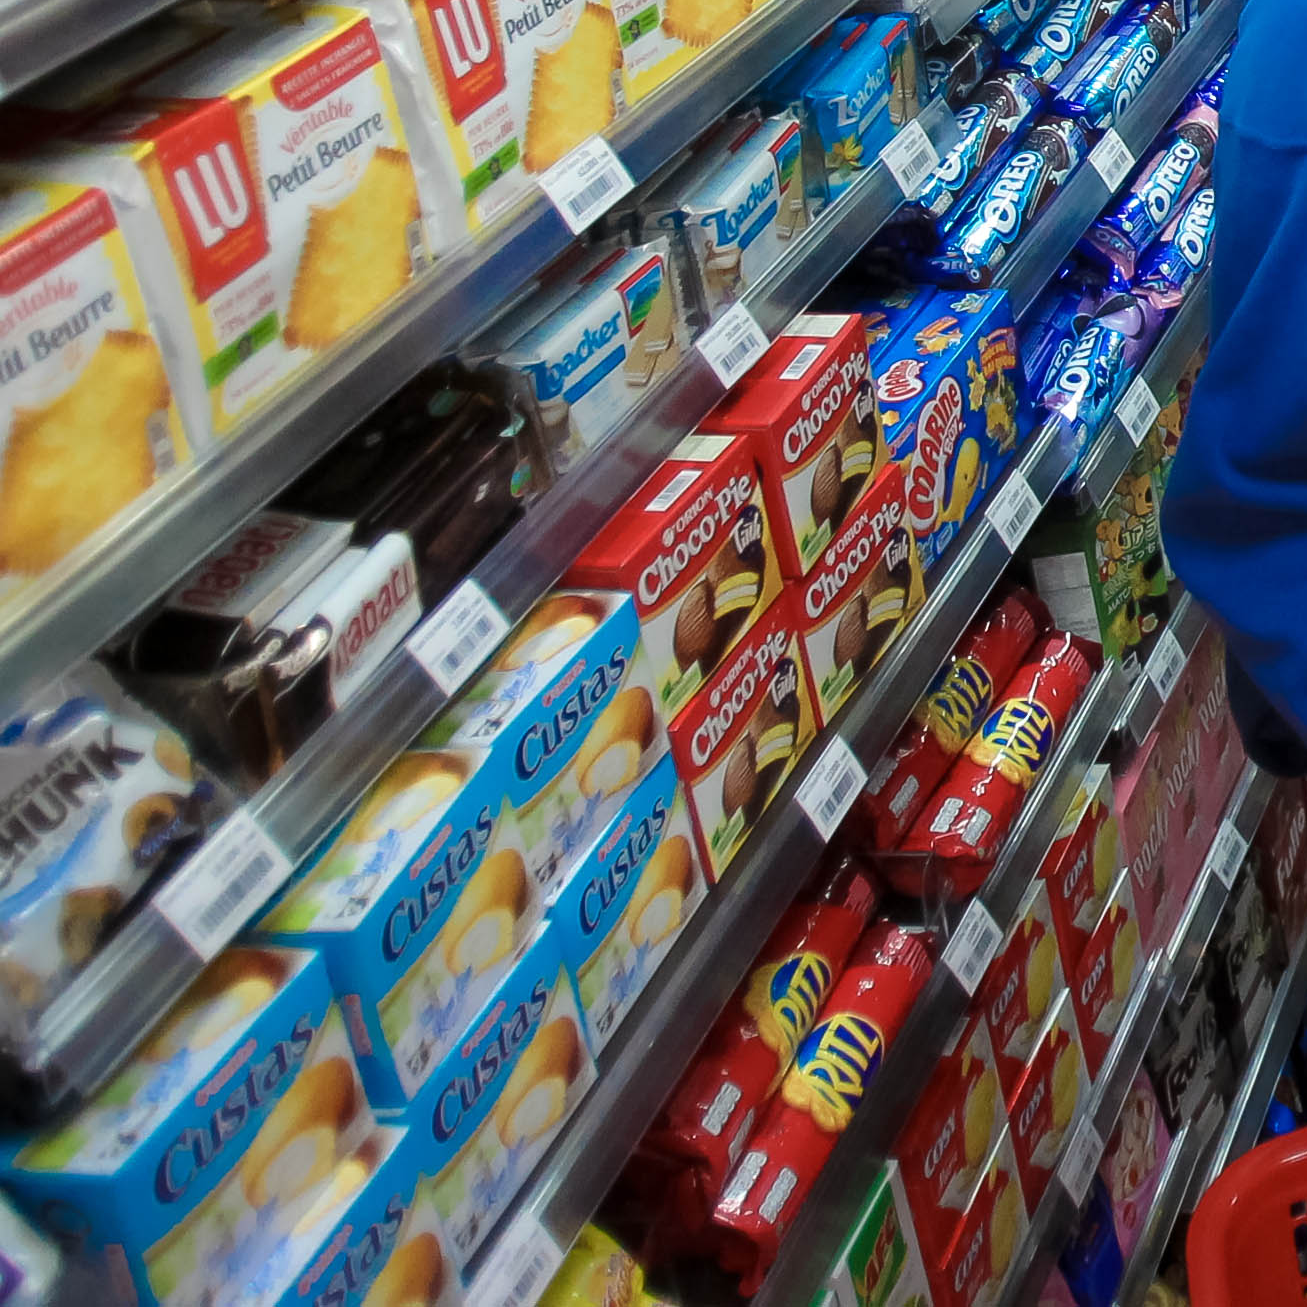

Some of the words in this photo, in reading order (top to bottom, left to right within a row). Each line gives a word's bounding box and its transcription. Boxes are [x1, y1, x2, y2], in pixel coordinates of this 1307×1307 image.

[503, 6, 543, 44] Petit
[174, 141, 248, 250] LU
[265, 156, 317, 202] Petit
[316, 111, 385, 169] Beurre
[983, 151, 1042, 236] OREO
[1146, 142, 1197, 224] OREO
[701, 168, 777, 248] Loacker
[27, 289, 115, 362] Beurre
[521, 309, 623, 402] Loacker
[1058, 326, 1101, 395] OREO
[810, 356, 841, 401] ORION
[673, 484, 715, 538] ORION
[834, 511, 869, 561] ORION
[719, 644, 754, 697] ORION
[514, 644, 630, 782] Custas
[981, 699, 1051, 777] RITZ
[381, 804, 496, 964] Custas
[578, 795, 668, 937] Custas
[431, 976, 551, 1144] Custas
[801, 1014, 884, 1119] RITZ
[154, 1011, 317, 1205] Custas
